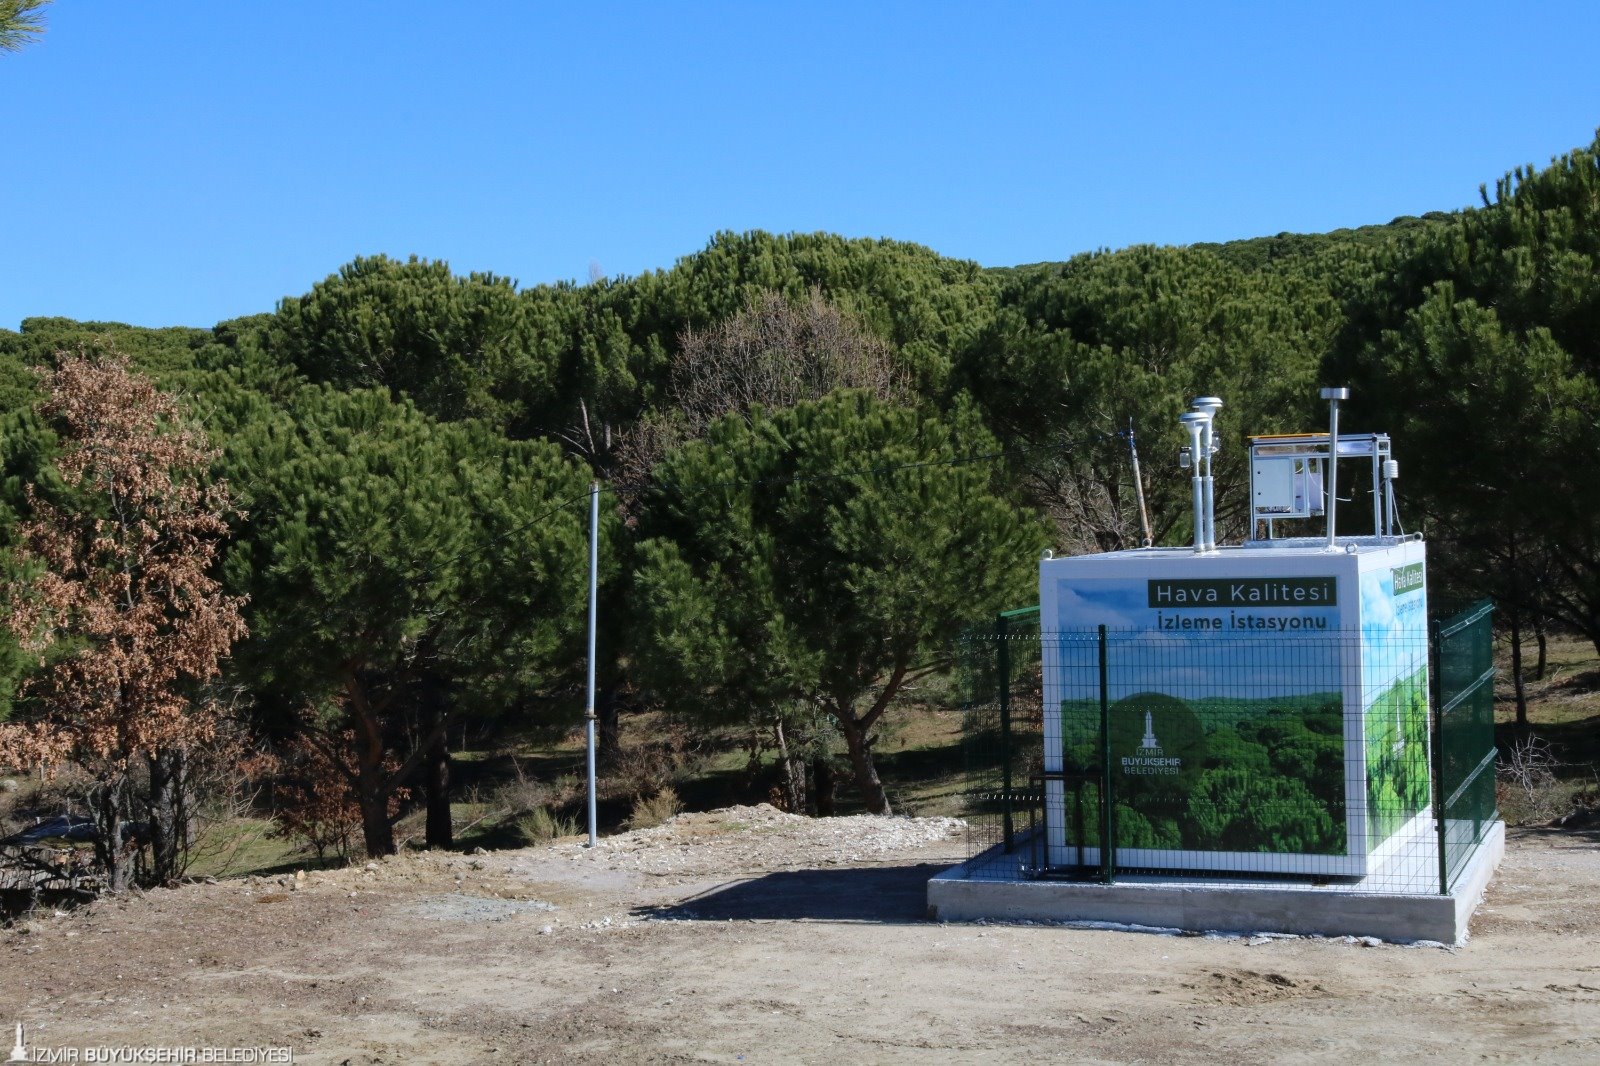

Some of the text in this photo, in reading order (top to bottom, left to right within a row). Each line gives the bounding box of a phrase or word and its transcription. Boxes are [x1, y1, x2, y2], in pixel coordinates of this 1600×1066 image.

[1157, 583, 1328, 602] Hava Kalitesi
[1158, 610, 1326, 632] İzleme İstasyonu
